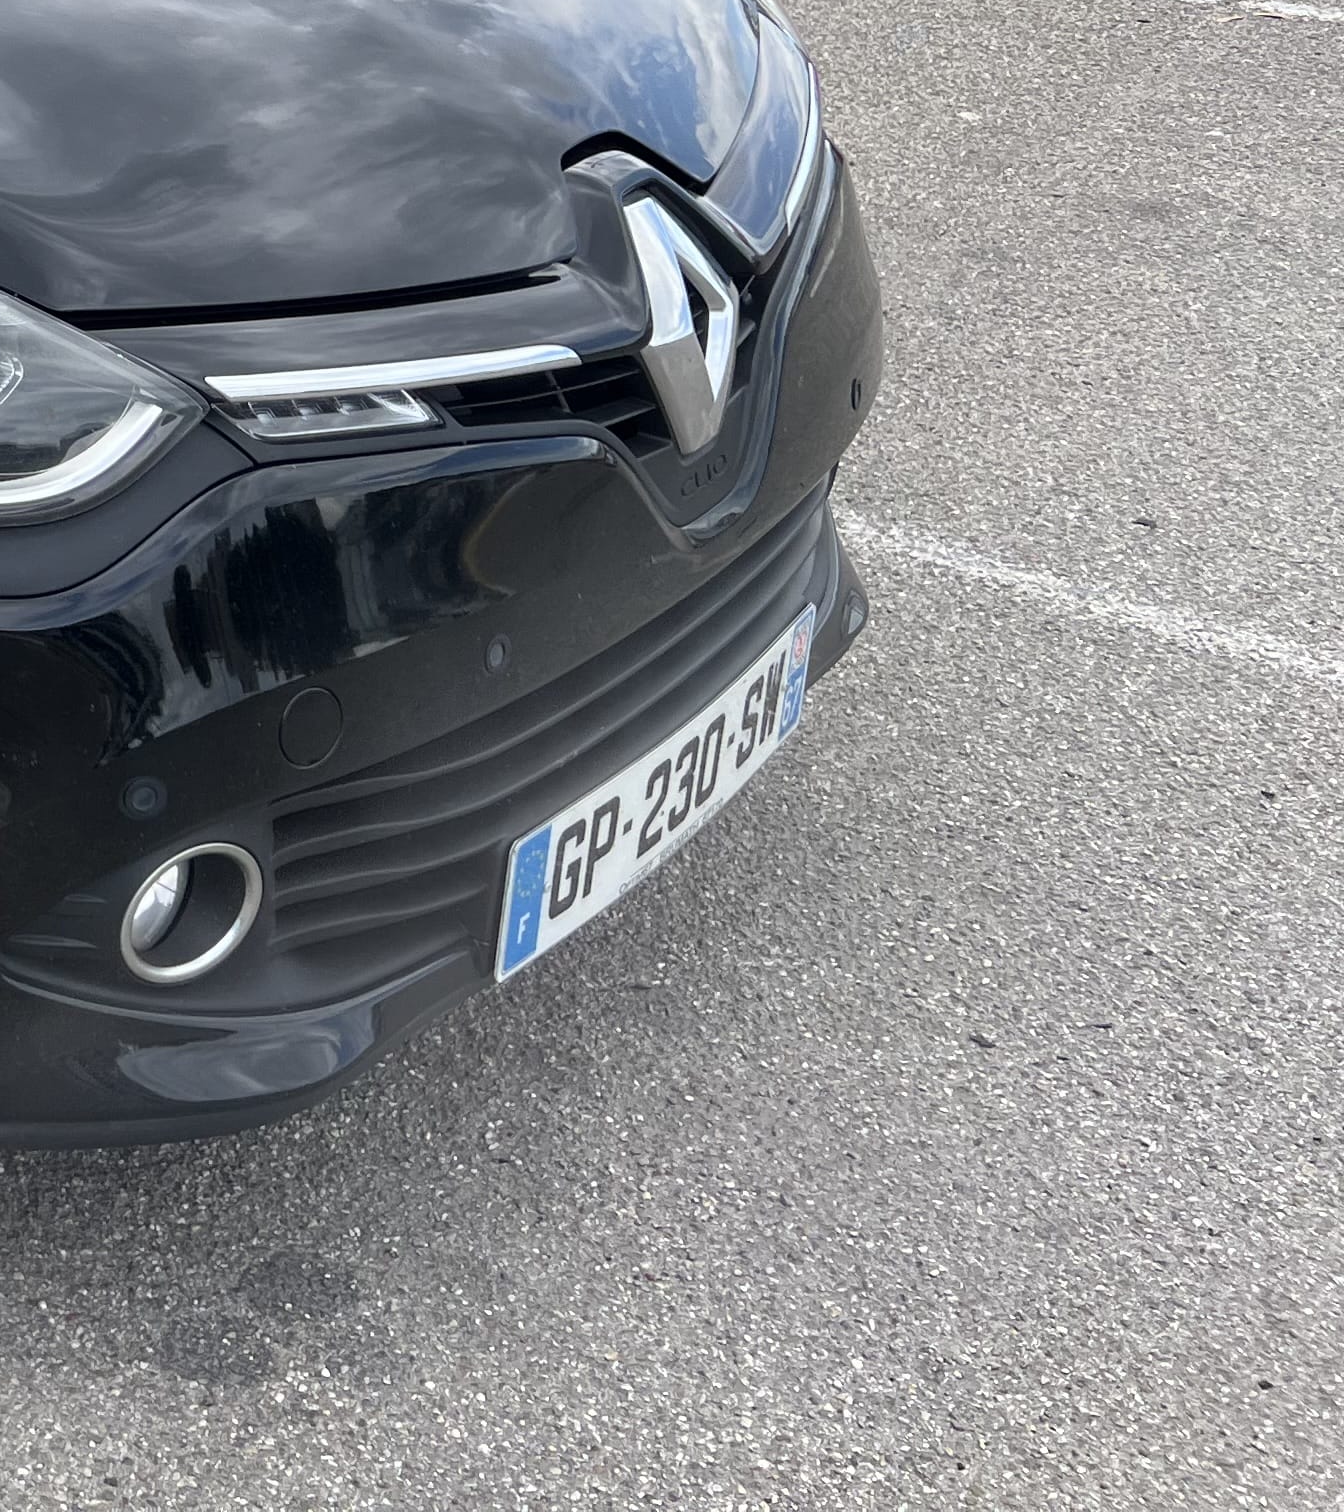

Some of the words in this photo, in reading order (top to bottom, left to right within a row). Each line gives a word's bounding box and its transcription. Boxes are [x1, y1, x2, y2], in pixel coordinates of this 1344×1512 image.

[679, 453, 729, 498] CLIO
[781, 673, 804, 727] 67
[548, 649, 787, 920] GP-230-SW
[516, 912, 531, 945] F
